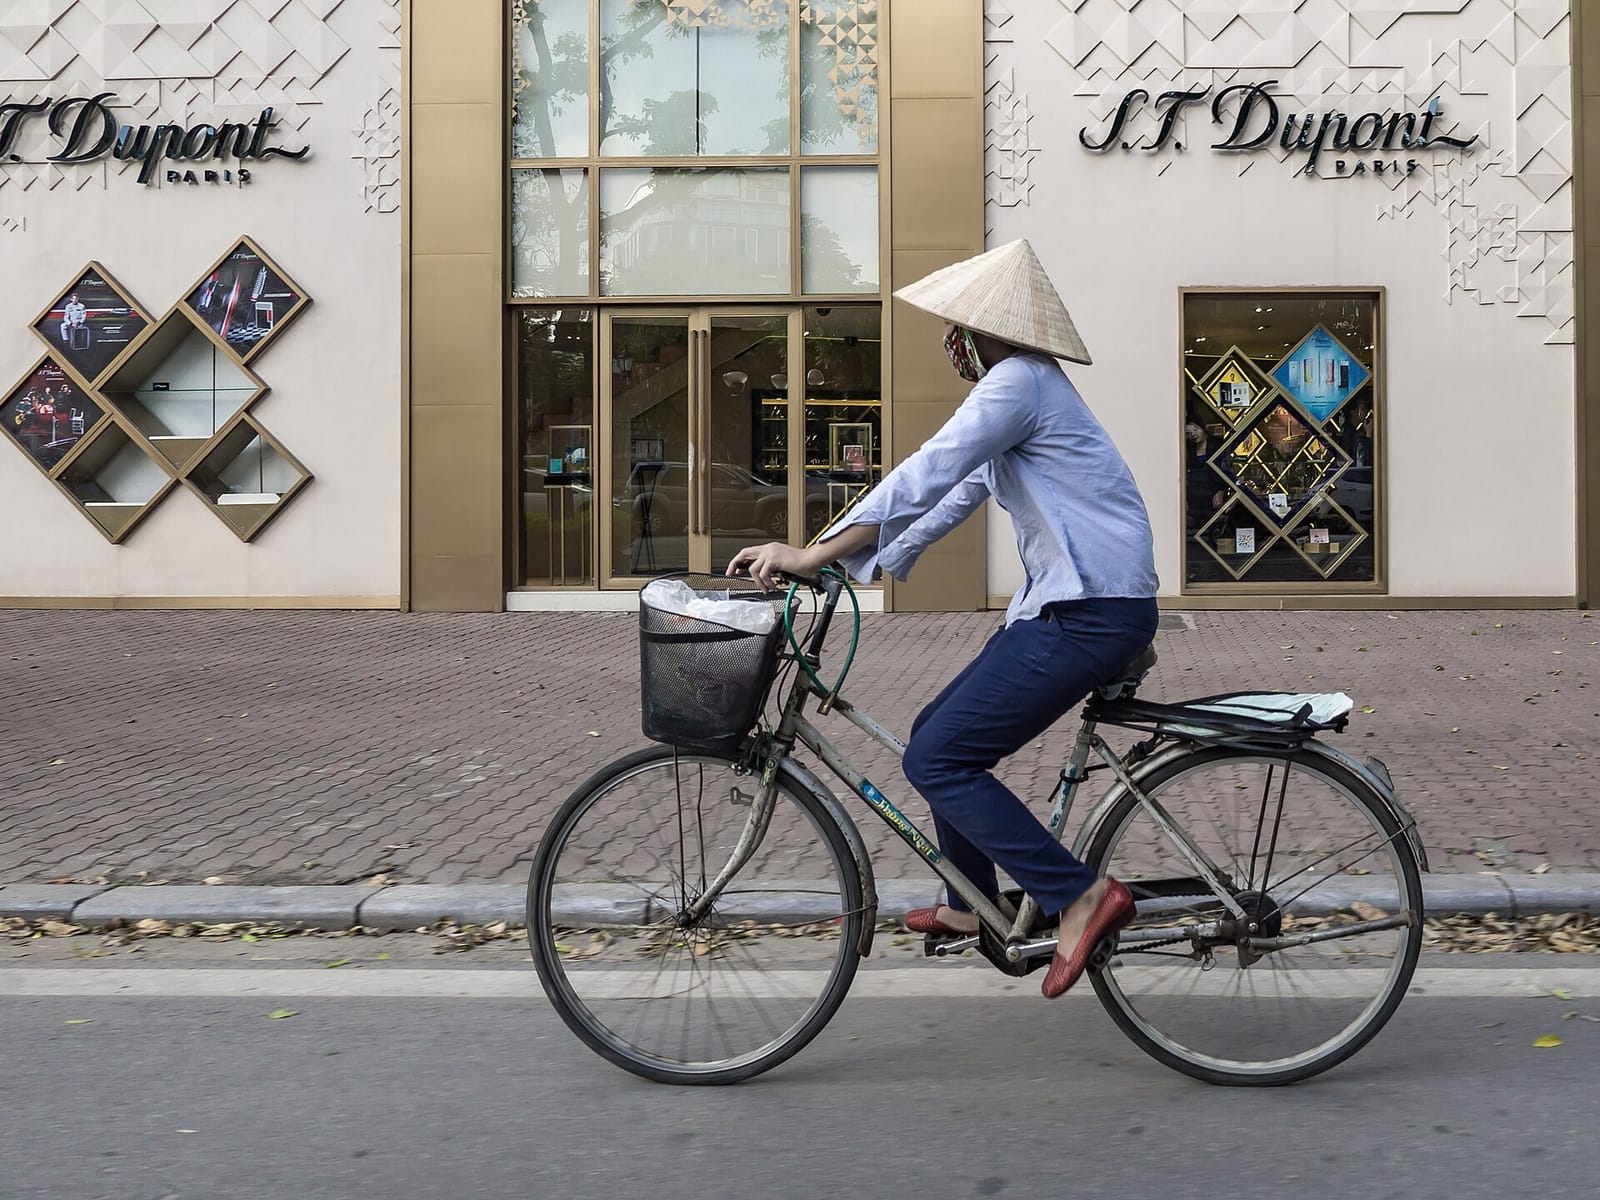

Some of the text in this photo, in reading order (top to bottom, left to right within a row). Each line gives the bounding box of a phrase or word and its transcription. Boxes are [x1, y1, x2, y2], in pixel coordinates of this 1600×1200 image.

[47, 92, 311, 185] Dupont
[1211, 80, 1479, 175] Dupont
[167, 169, 251, 184] PARIS
[1336, 159, 1418, 174] PARIS
